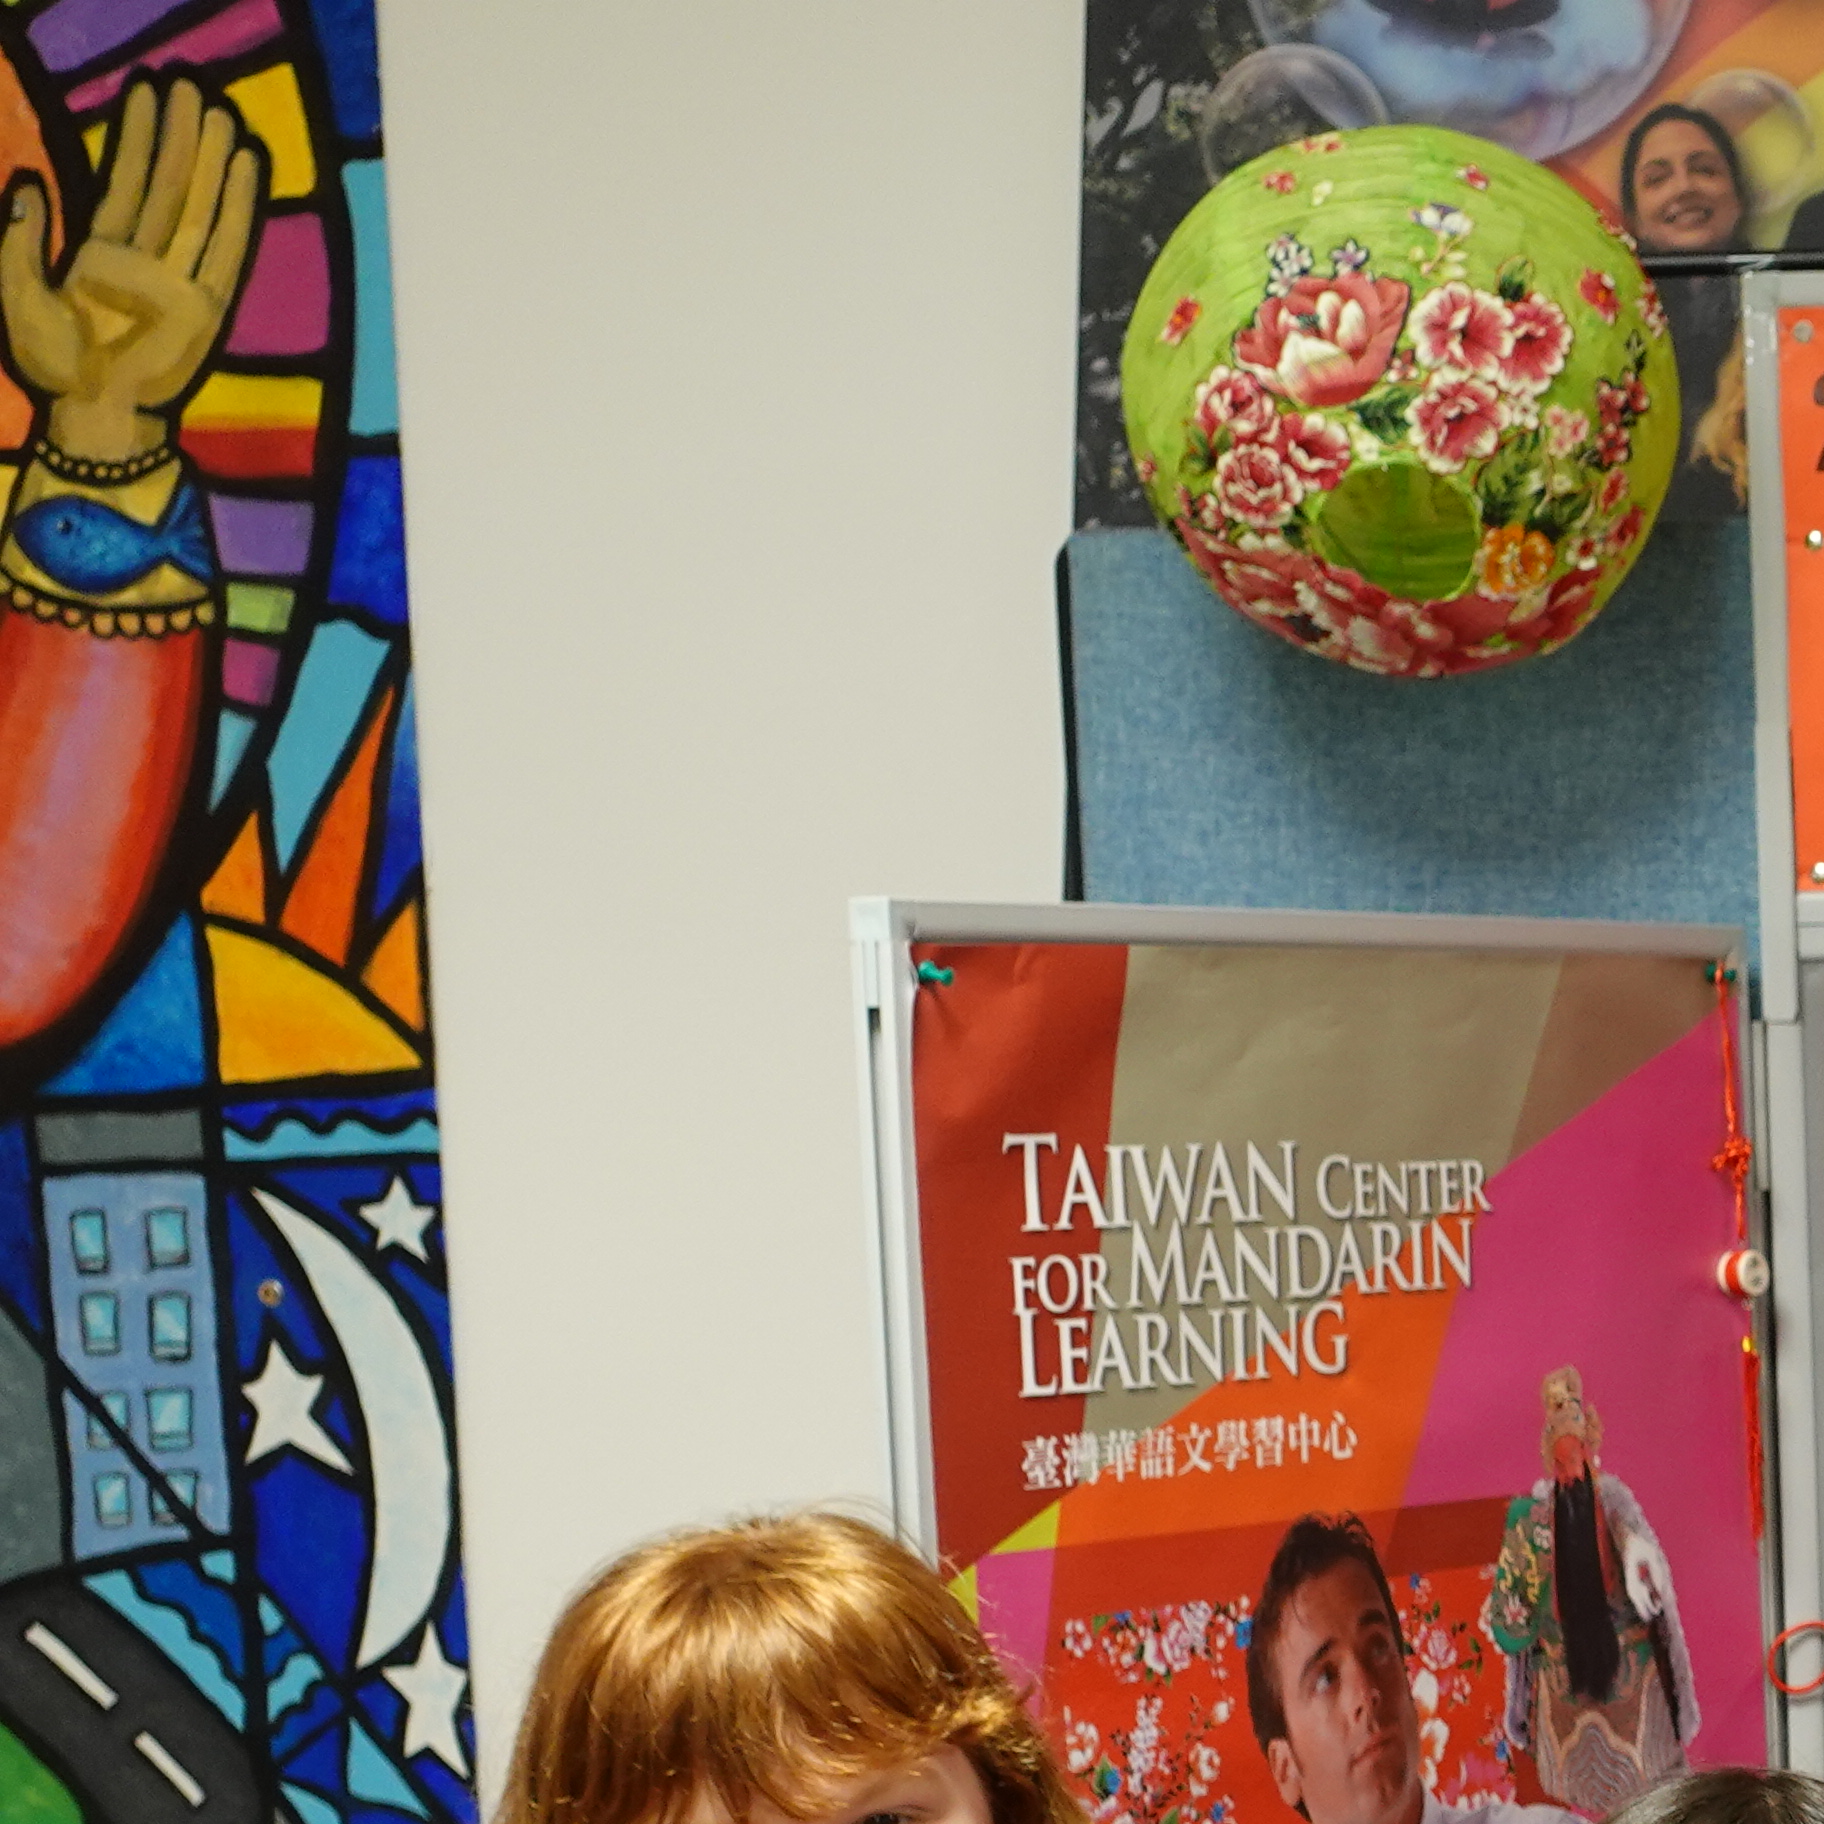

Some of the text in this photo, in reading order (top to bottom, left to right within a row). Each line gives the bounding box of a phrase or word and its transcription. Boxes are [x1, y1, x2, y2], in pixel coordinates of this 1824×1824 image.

[1002, 1132, 1492, 1233] TAIWAN CENTER
[1010, 1217, 1474, 1315] FOR MANDARIN
[1019, 1301, 1348, 1398] LEARNING
[1021, 1410, 1358, 1491] 臺灣華語文學習中心
